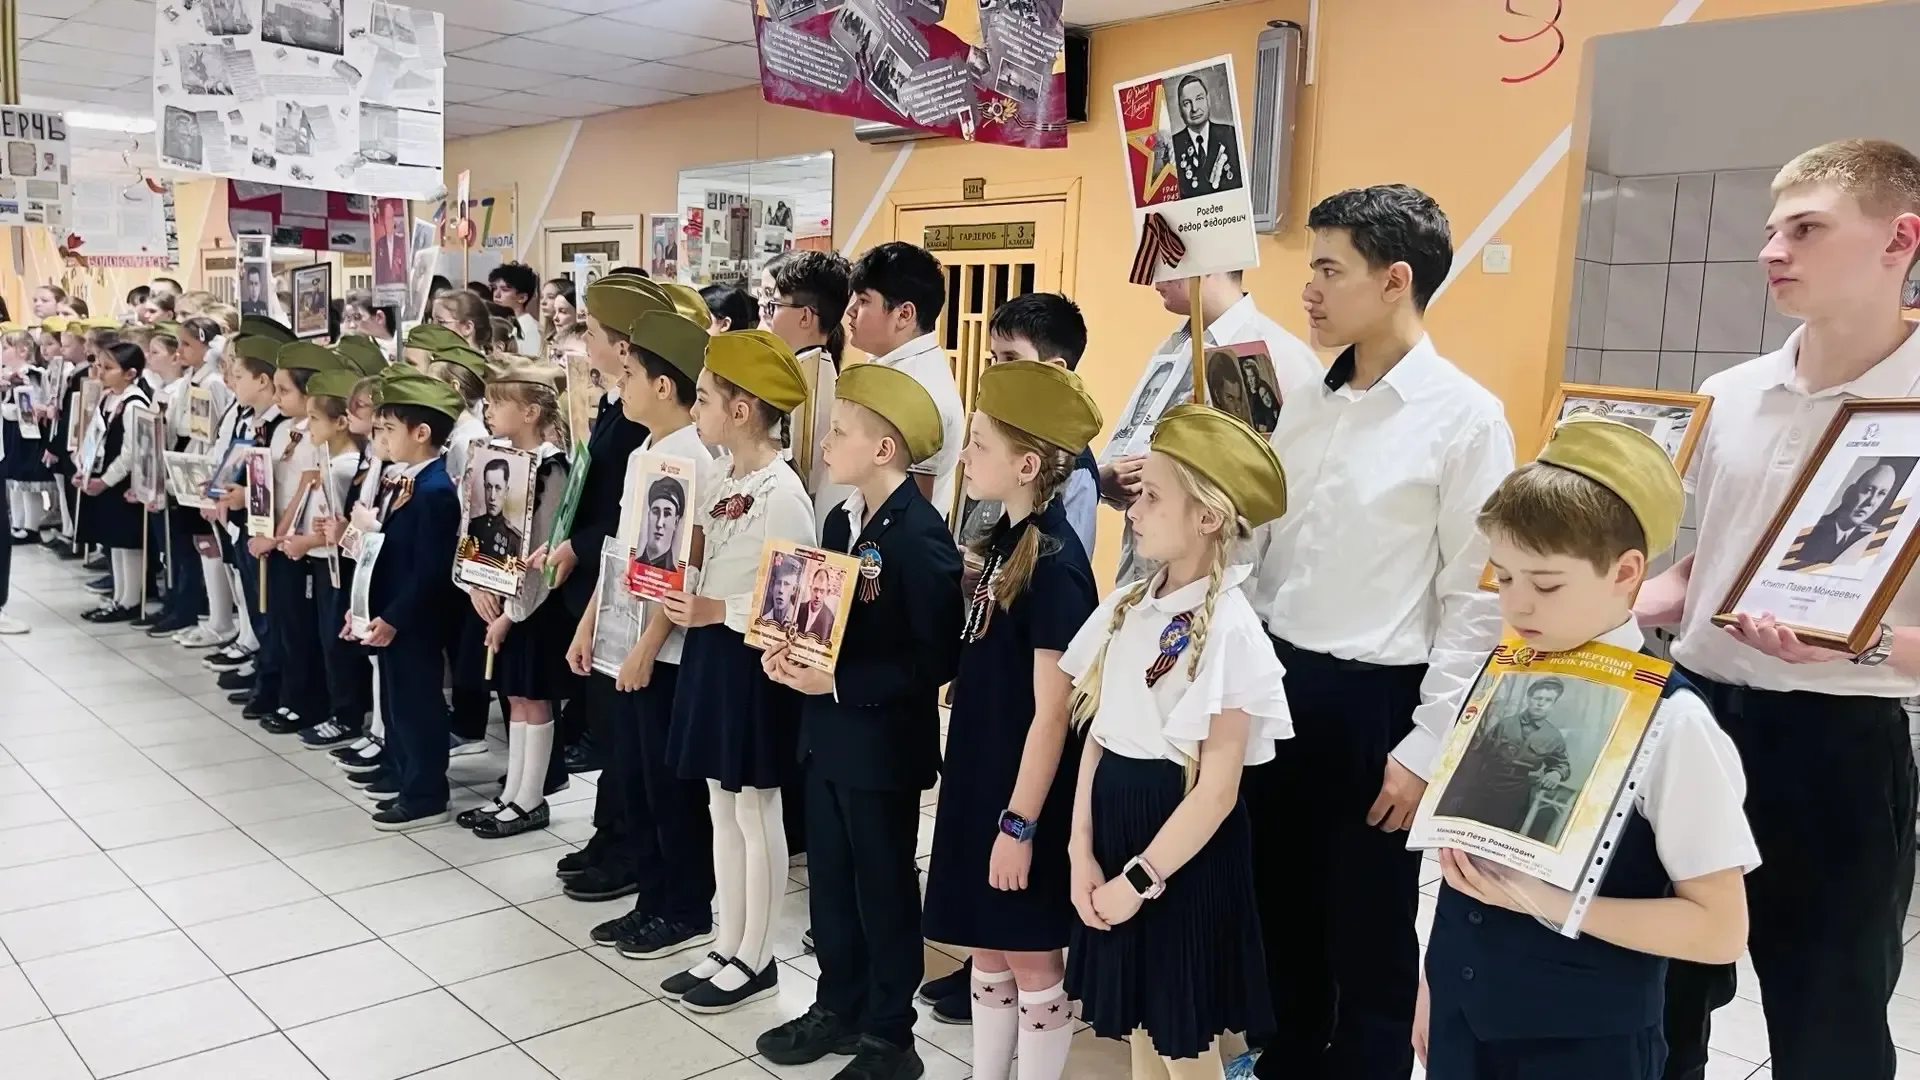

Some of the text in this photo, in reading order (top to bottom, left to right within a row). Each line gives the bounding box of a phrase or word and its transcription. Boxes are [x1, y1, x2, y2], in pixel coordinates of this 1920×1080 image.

[1018, 19, 1031, 30] 1944
[1196, 204, 1224, 217] Рогдев
[1018, 225, 1024, 238] 3
[1178, 214, 1246, 234] Фёдор Фёдорович
[934, 229, 941, 241] 2
[959, 231, 997, 241] ГАРДЕРОБ
[1786, 582, 1813, 594] Павел
[1813, 586, 1862, 600] Моисеевич
[1549, 657, 1626, 678] ПОЛК РОССИИ
[1551, 651, 1633, 671] БЕССМЕРТНЫЙ
[1488, 838, 1536, 859] Романович
